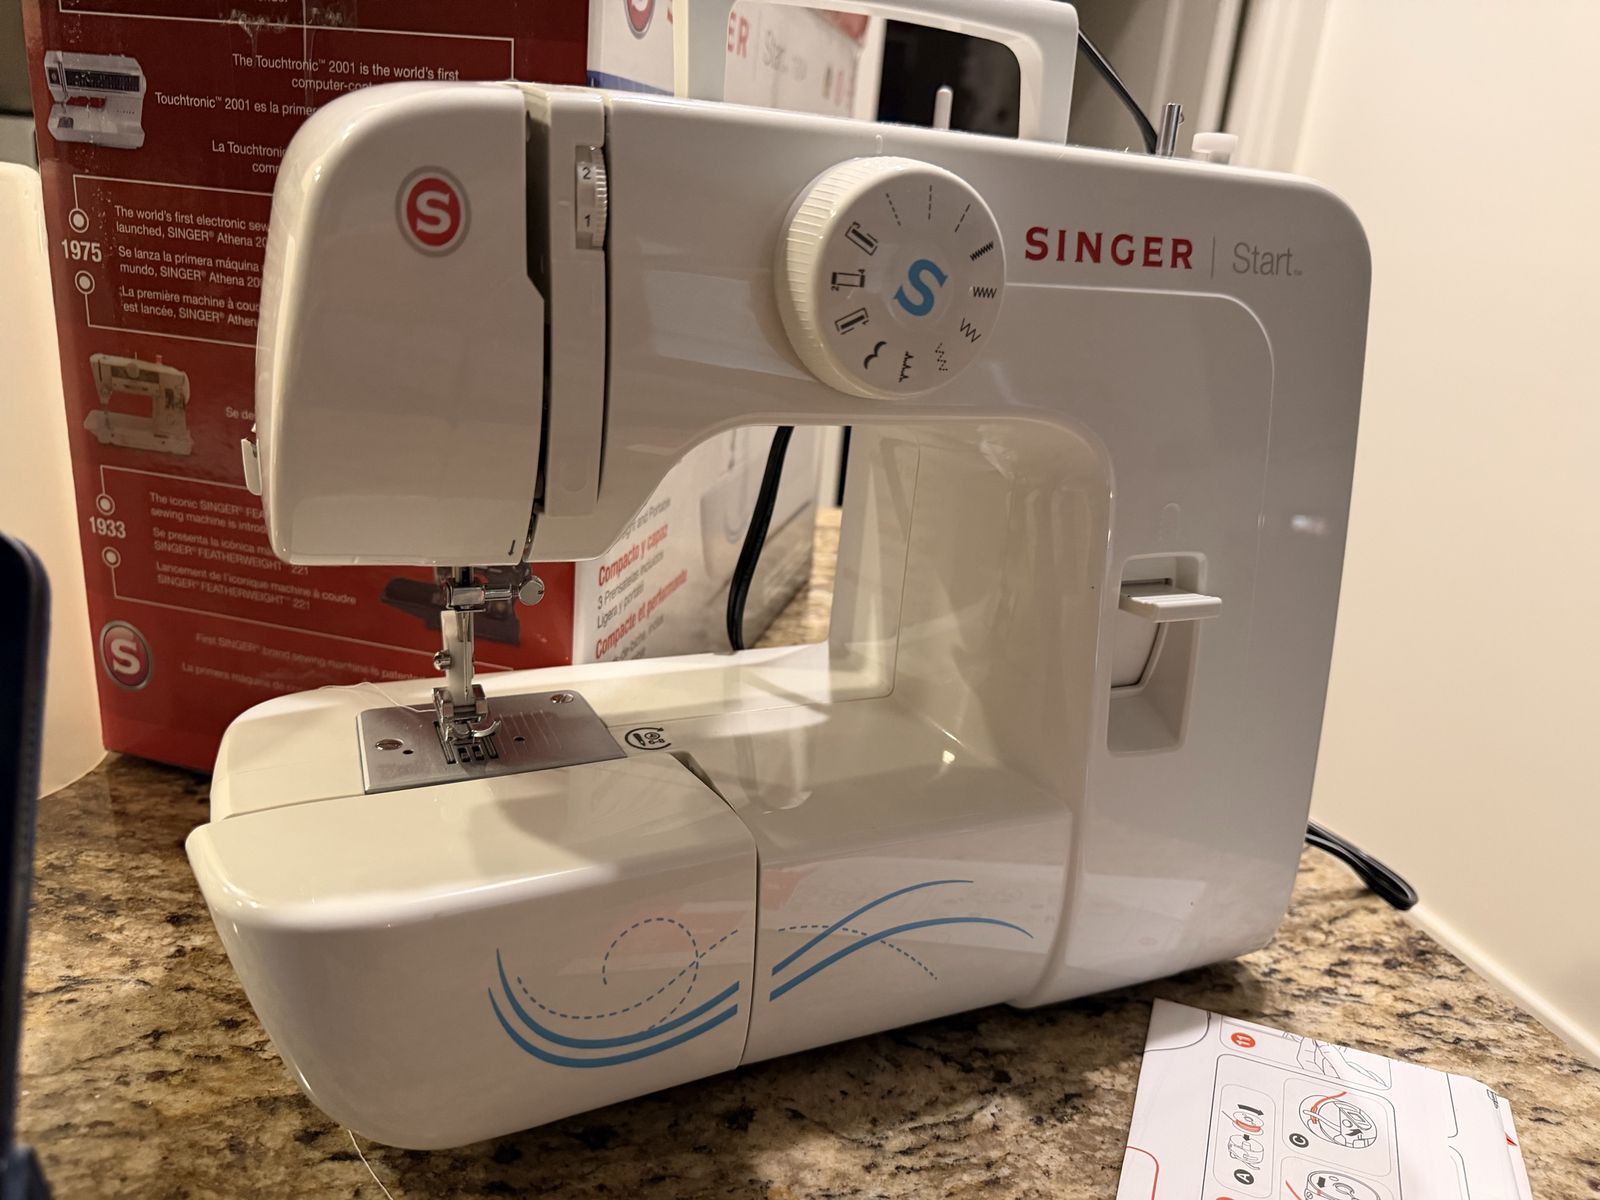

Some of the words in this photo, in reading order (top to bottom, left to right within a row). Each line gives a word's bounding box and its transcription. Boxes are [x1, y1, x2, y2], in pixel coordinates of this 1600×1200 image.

[232, 53, 253, 67] The
[328, 60, 355, 75] 2001
[359, 62, 370, 75] is
[372, 63, 390, 77] the
[393, 66, 434, 80] world's
[437, 68, 459, 81] first
[224, 97, 250, 111] 2001
[254, 102, 267, 112] es
[269, 101, 279, 114] la
[212, 140, 225, 152] La
[583, 167, 591, 180] 2
[114, 205, 134, 218] The
[136, 209, 172, 222] world's
[174, 211, 194, 224] first
[196, 214, 246, 230] electronic
[416, 190, 451, 234] S
[584, 214, 591, 227] 1
[116, 221, 165, 239] launched,
[217, 232, 253, 247] Athena
[61, 239, 102, 263] 1975
[118, 245, 132, 258] Se
[134, 247, 161, 261] lanza
[163, 250, 172, 262] la
[174, 252, 213, 267] primera
[215, 257, 259, 272] máquina
[1025, 226, 1193, 270] SINGER
[120, 264, 158, 278] mundo,
[209, 271, 245, 286] Athena
[122, 285, 135, 298] La
[137, 289, 180, 303] première
[182, 294, 225, 309] machine
[227, 297, 235, 310] à
[123, 303, 139, 313] est
[225, 406, 240, 419] Se
[149, 491, 167, 504] The
[170, 495, 198, 509] iconic
[89, 516, 126, 538] 1933
[150, 508, 184, 522] sewing
[186, 513, 226, 528] machine
[228, 520, 237, 529] is
[153, 527, 166, 538] Se
[168, 531, 208, 545] presenta
[211, 537, 219, 547] la
[598, 544, 640, 587] Compacto
[209, 571, 222, 580] de
[271, 582, 312, 598] machine
[321, 592, 357, 605] coudre
[110, 638, 141, 675] S
